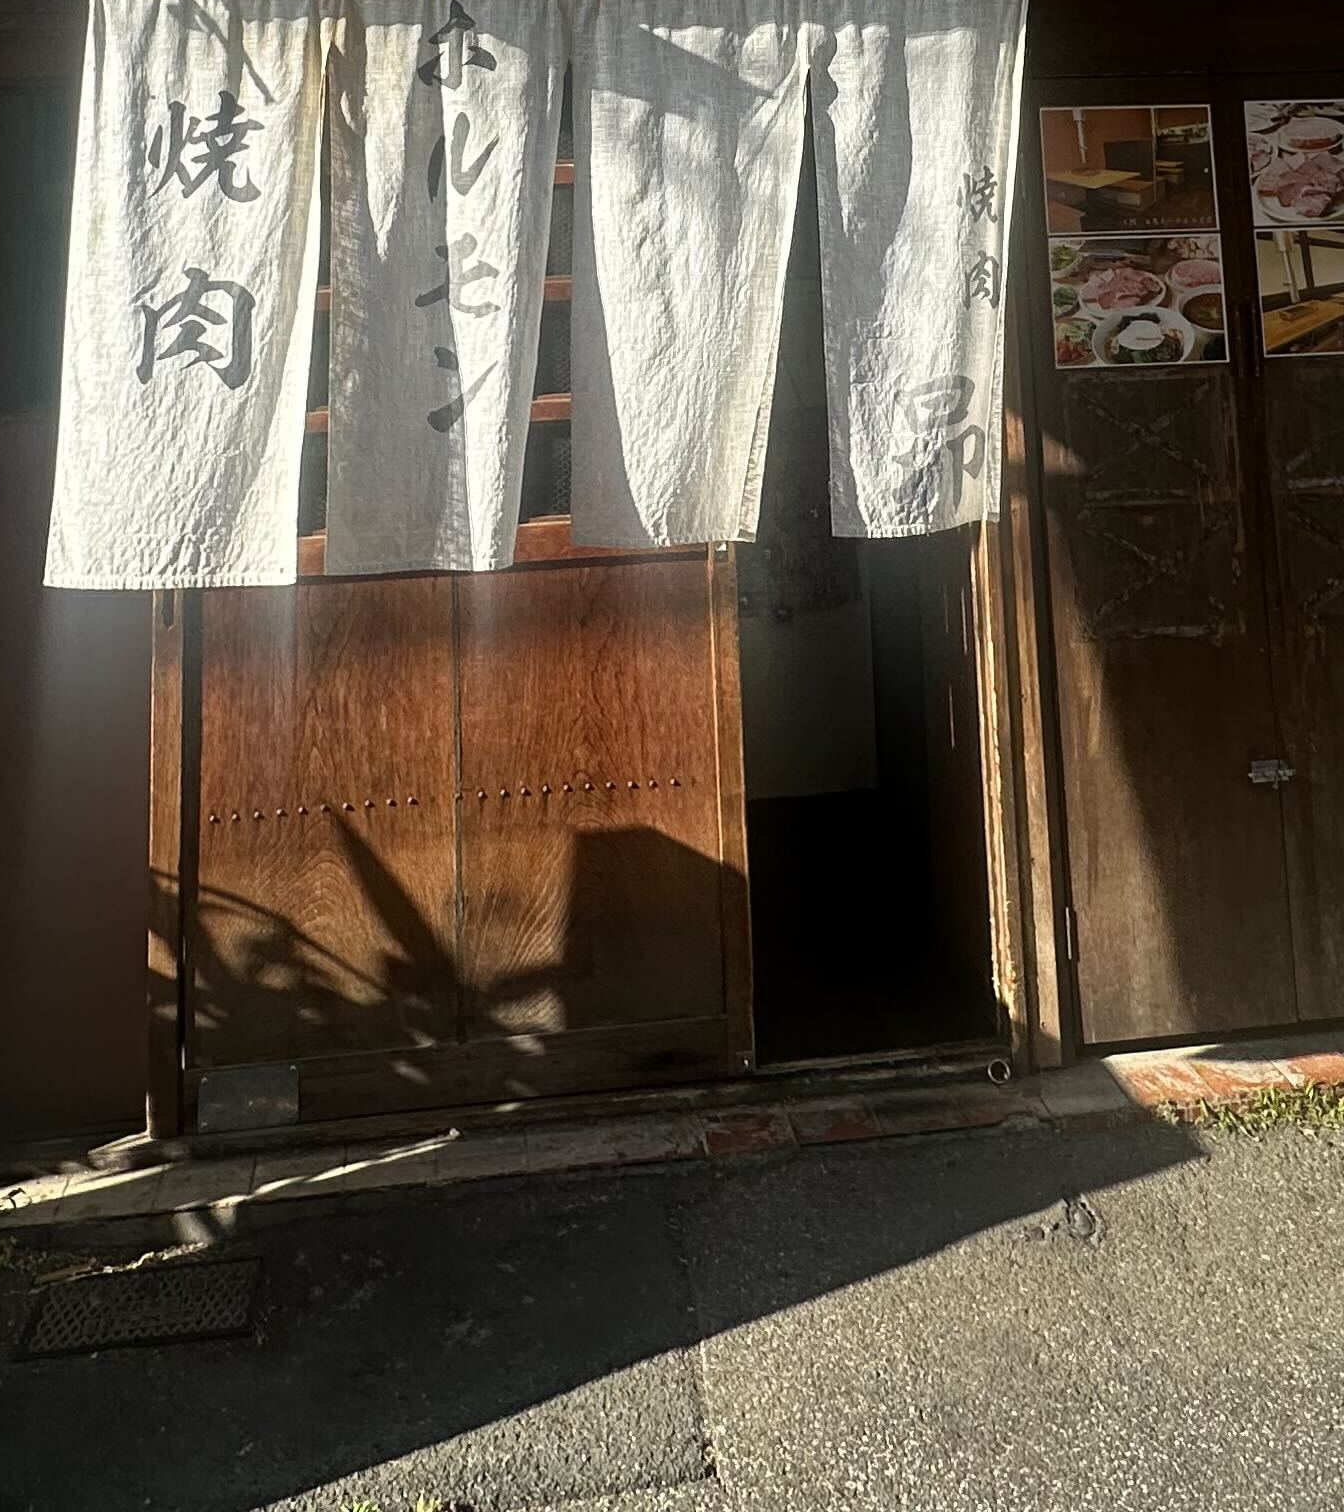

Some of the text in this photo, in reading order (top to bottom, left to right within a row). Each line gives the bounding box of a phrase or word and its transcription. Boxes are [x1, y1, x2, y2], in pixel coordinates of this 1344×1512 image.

[135, 90, 262, 392] 焼肉
[415, 0, 500, 436] ホルモン
